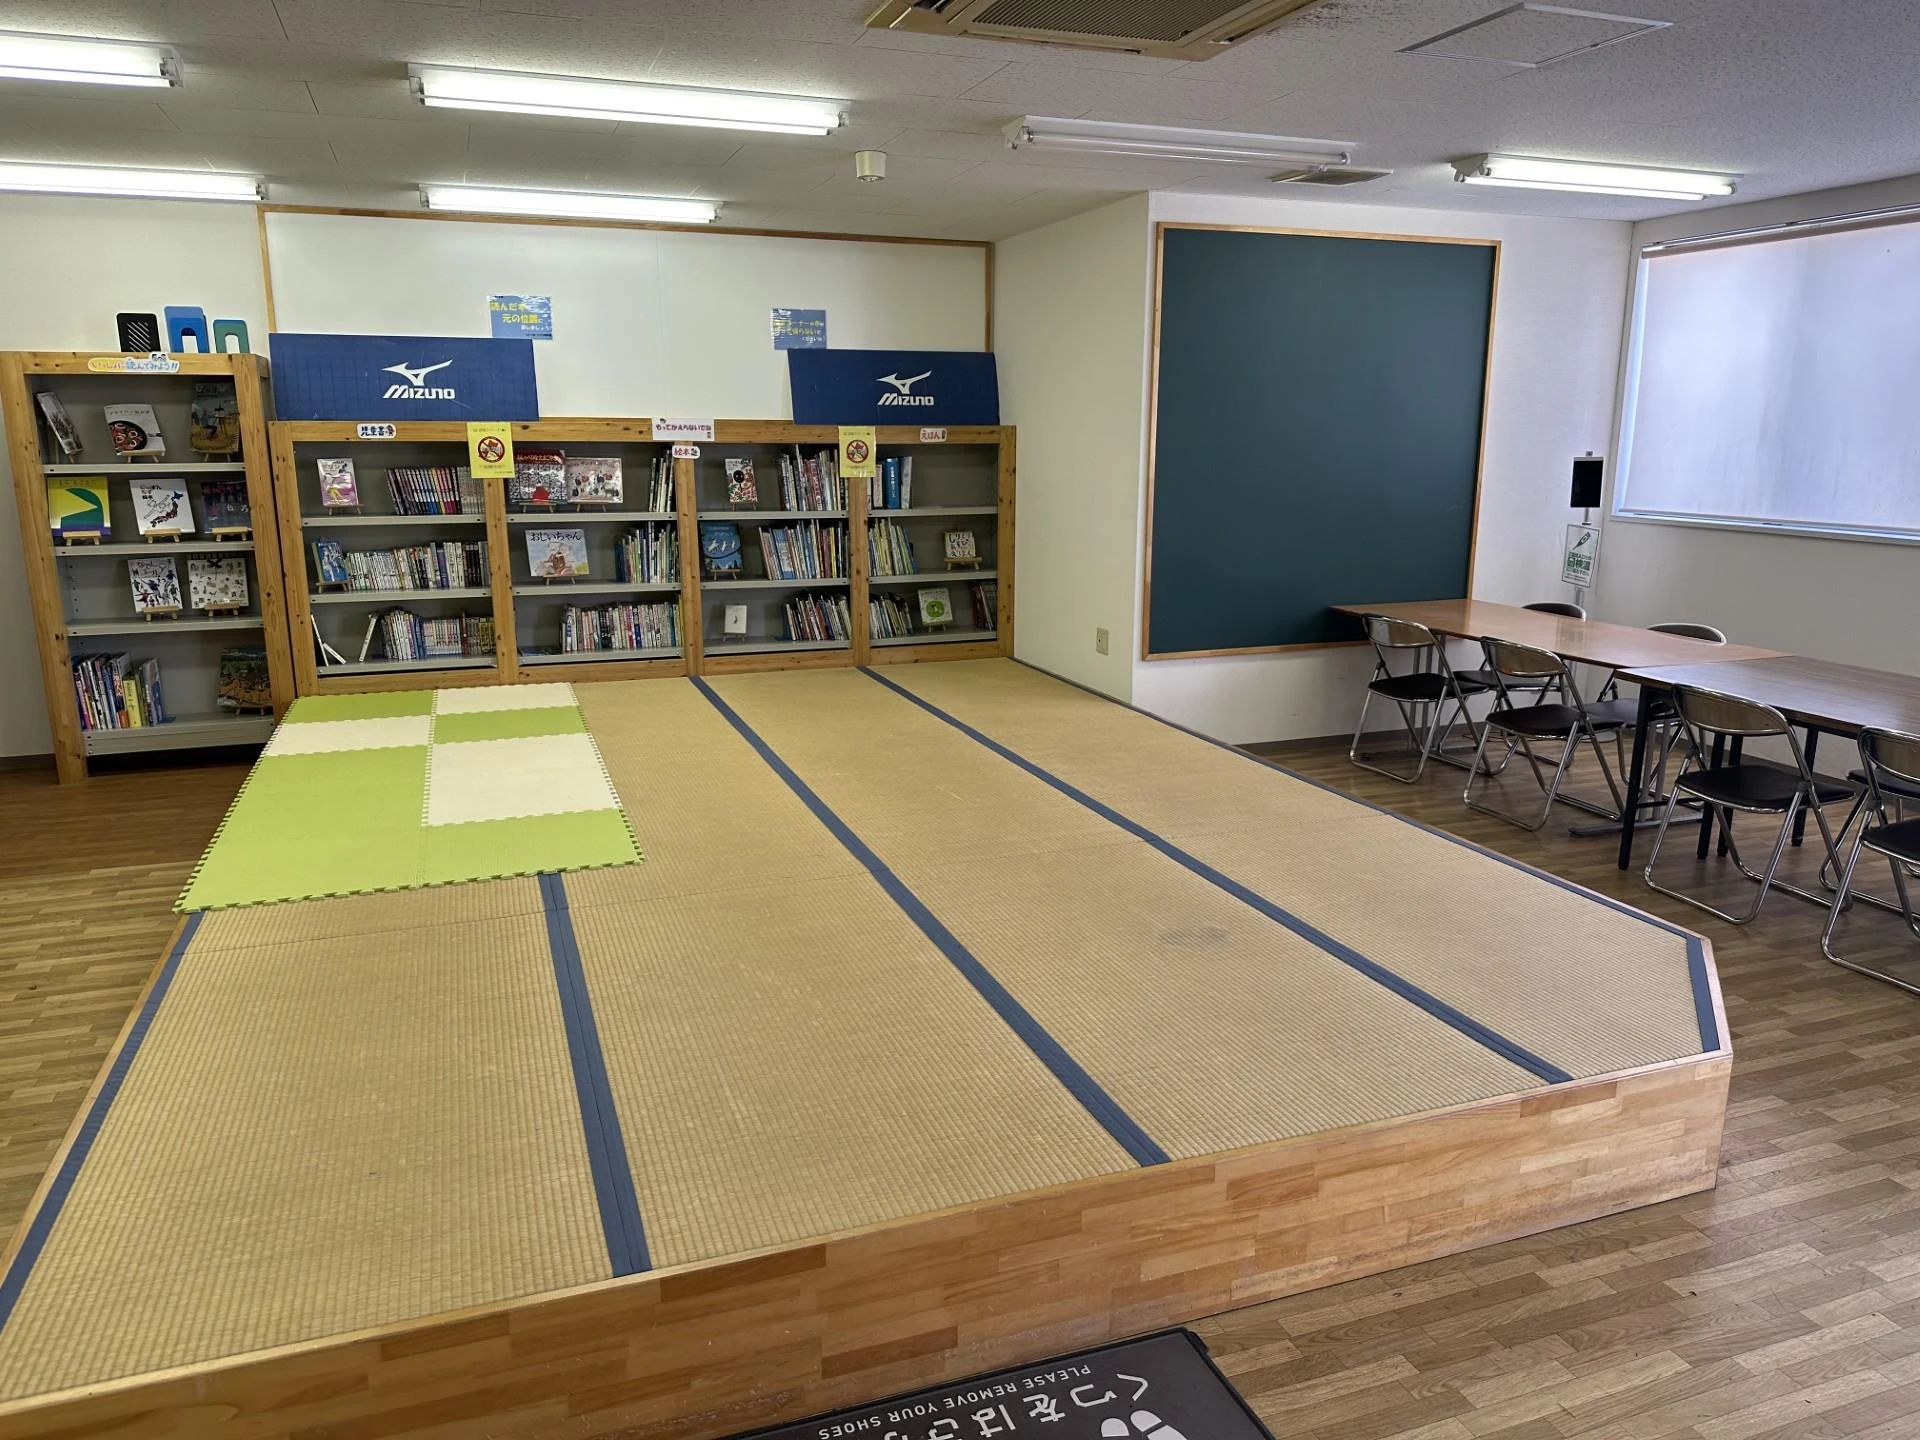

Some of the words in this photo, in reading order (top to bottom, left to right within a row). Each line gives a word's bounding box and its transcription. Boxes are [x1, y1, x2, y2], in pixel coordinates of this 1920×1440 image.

[382, 384, 456, 399] MIZUNO
[877, 392, 935, 406] MIZUNO
[360, 425, 386, 436] 児童書
[921, 430, 941, 440] えほん
[674, 447, 690, 456] 絵本
[530, 531, 582, 541] おじいちゃん
[1022, 1364, 1092, 1389] PLEASE
[943, 1383, 1017, 1409] REMOVE
[887, 1402, 938, 1422] YOUR
[818, 1416, 882, 1440] SHOES
